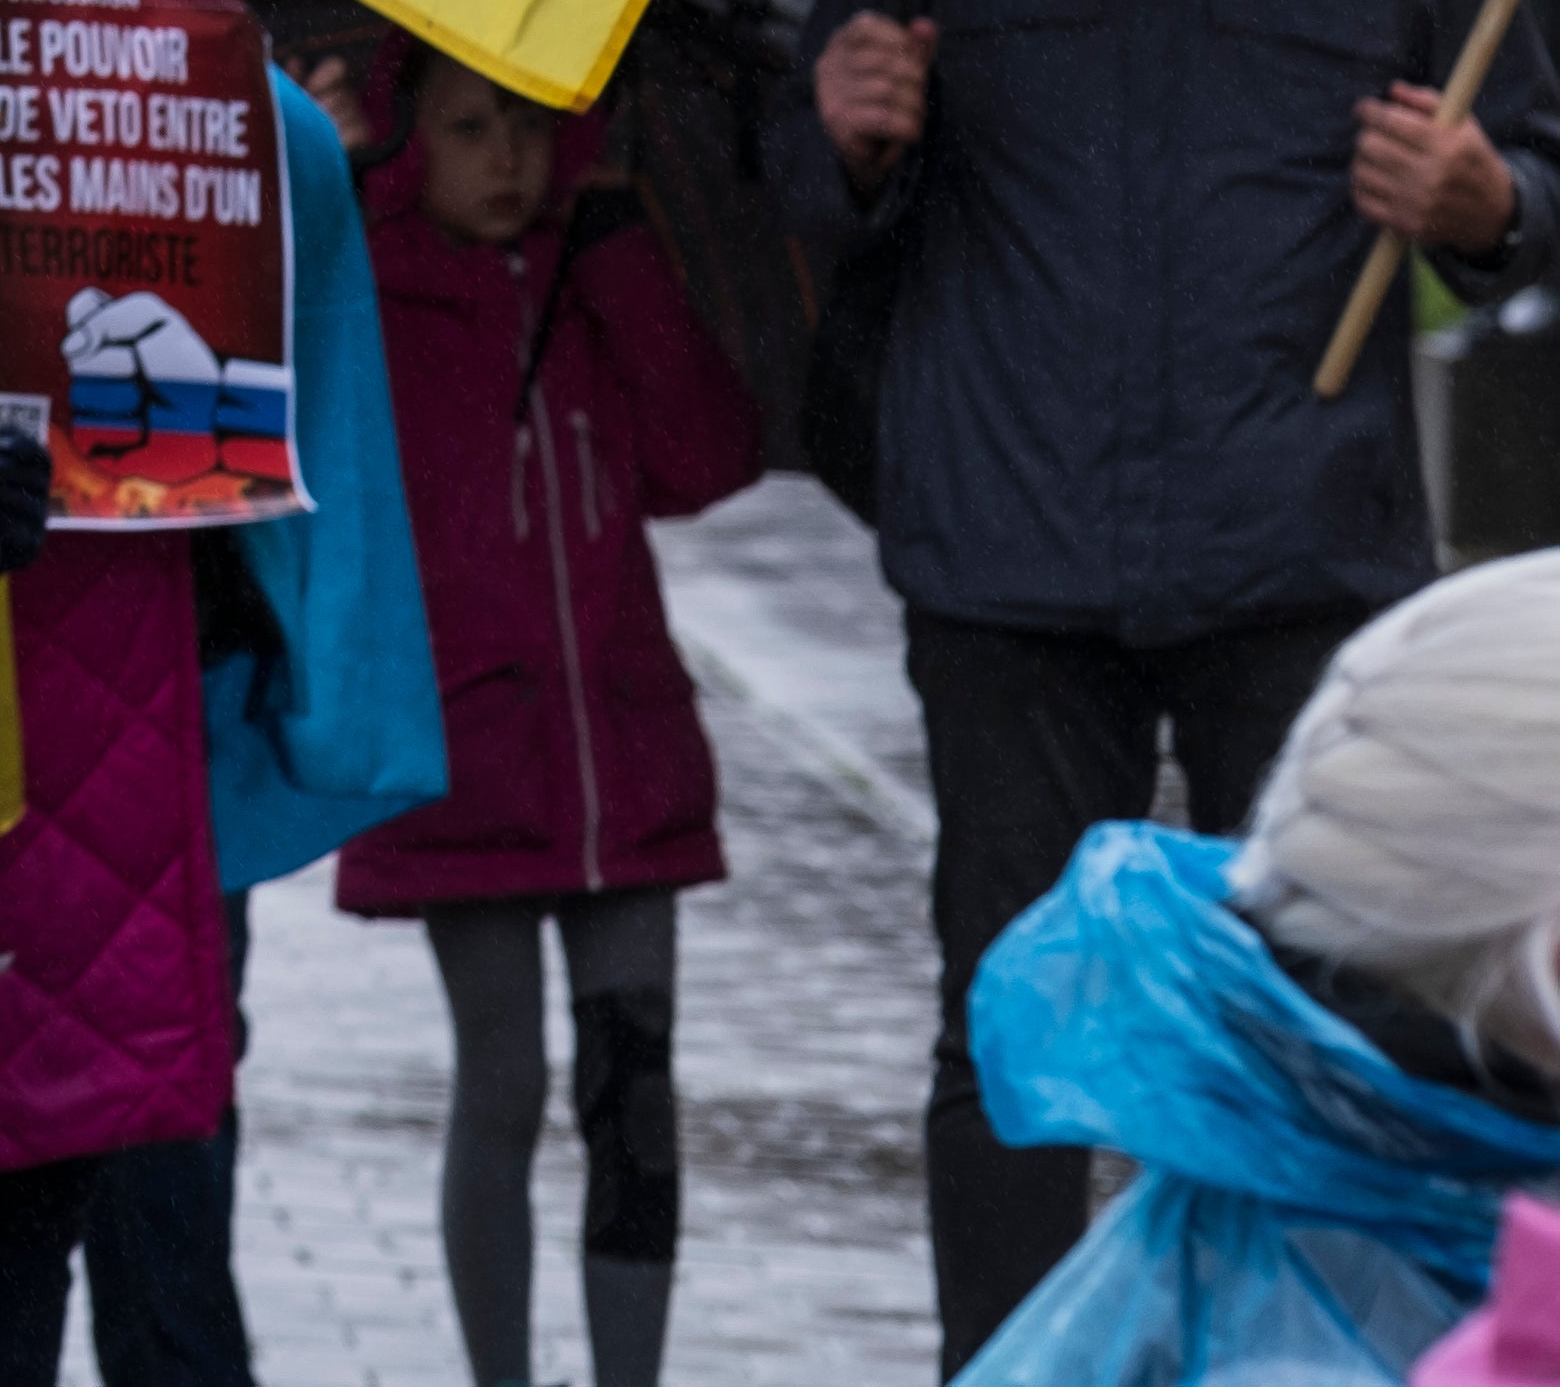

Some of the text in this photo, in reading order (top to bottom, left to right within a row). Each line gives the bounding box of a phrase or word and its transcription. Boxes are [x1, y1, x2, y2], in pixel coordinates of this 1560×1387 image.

[39, 19, 189, 85] POUVOIR
[47, 86, 144, 148] VETO
[147, 93, 250, 158] ENTRE
[69, 155, 181, 219] MAINS
[183, 164, 262, 227] D'UN
